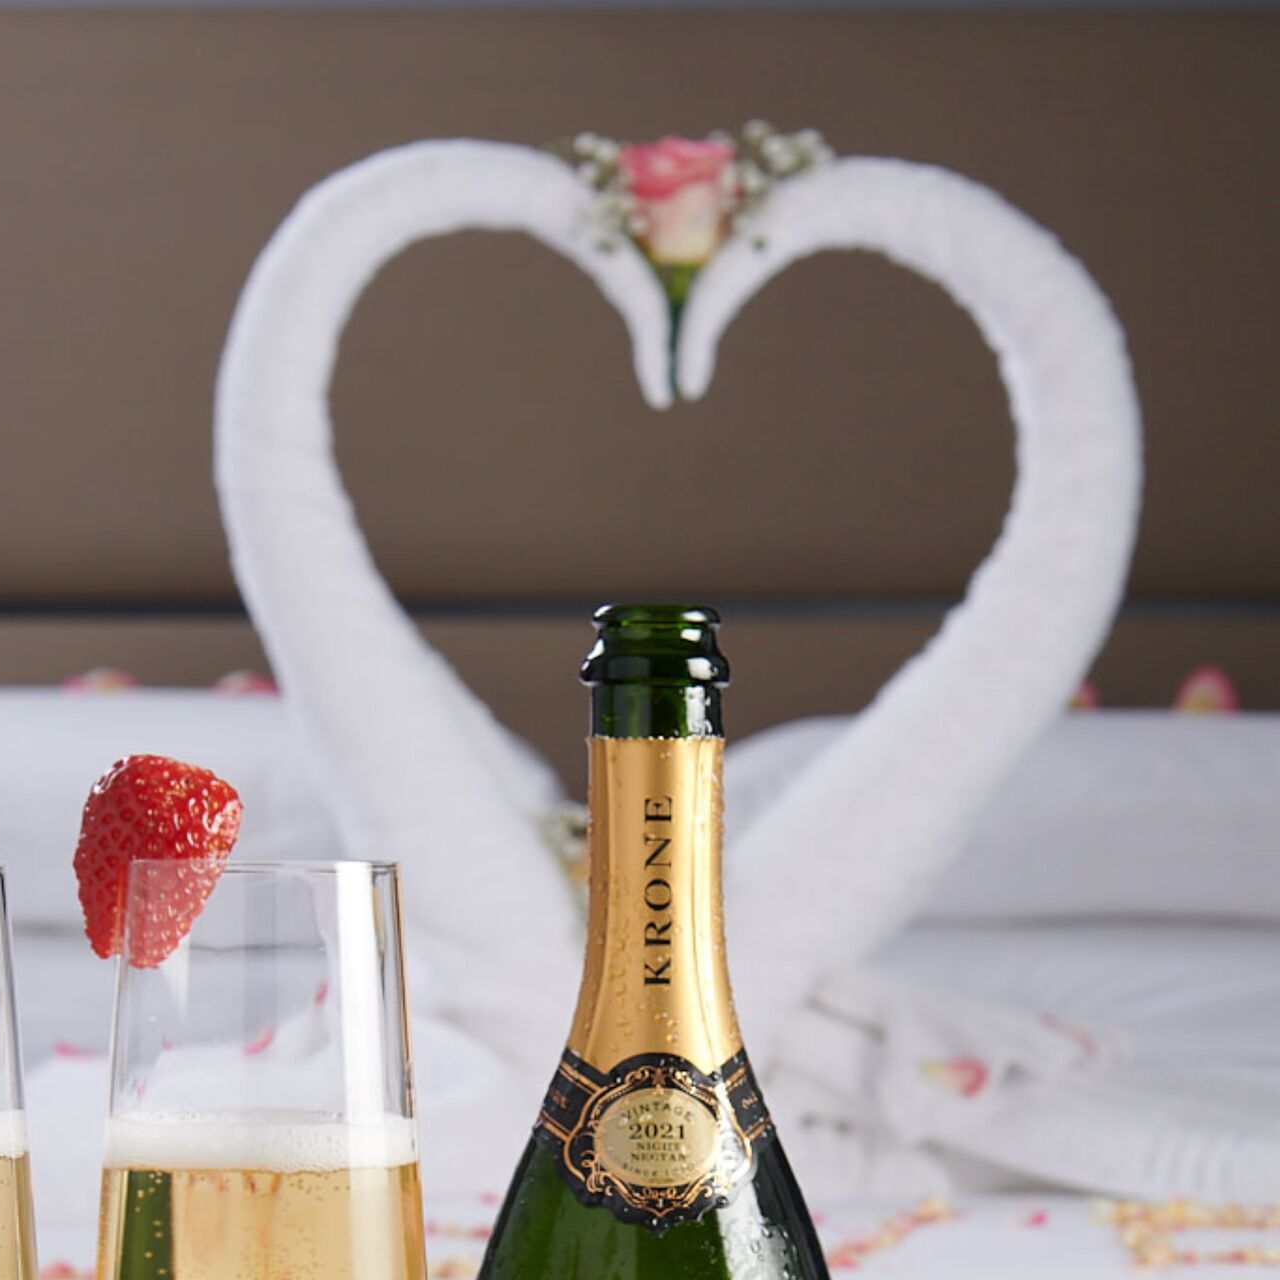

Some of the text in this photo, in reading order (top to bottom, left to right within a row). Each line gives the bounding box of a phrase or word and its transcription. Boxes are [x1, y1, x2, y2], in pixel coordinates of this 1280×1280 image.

[643, 795, 673, 987] KRONE
[621, 1101, 694, 1123] VINTAGE
[629, 1123, 685, 1140] 2021
[636, 1142, 682, 1152] NIGHT
